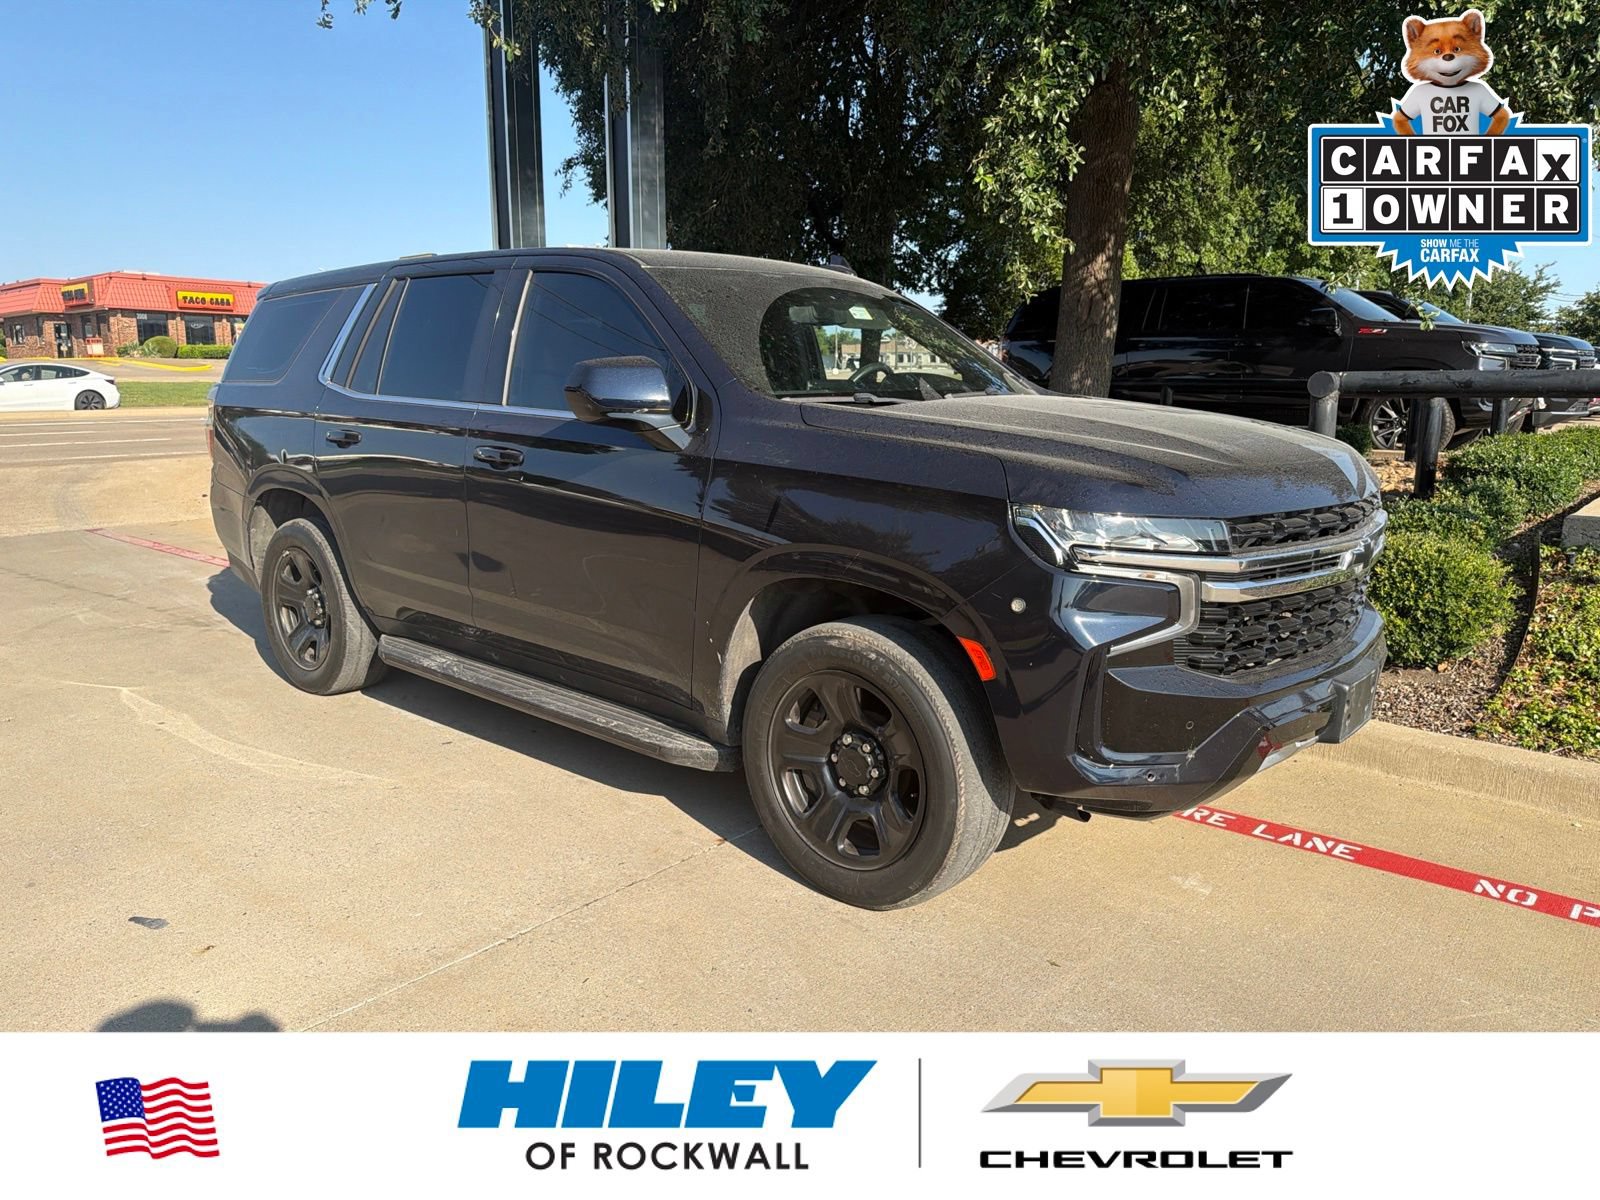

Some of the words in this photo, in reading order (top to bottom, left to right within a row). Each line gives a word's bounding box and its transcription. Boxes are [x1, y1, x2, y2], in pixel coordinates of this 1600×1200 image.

[182, 296, 206, 305] TACO
[209, 298, 231, 306] CASA
[1252, 824, 1362, 860] LANE
[1473, 879, 1538, 906] NO
